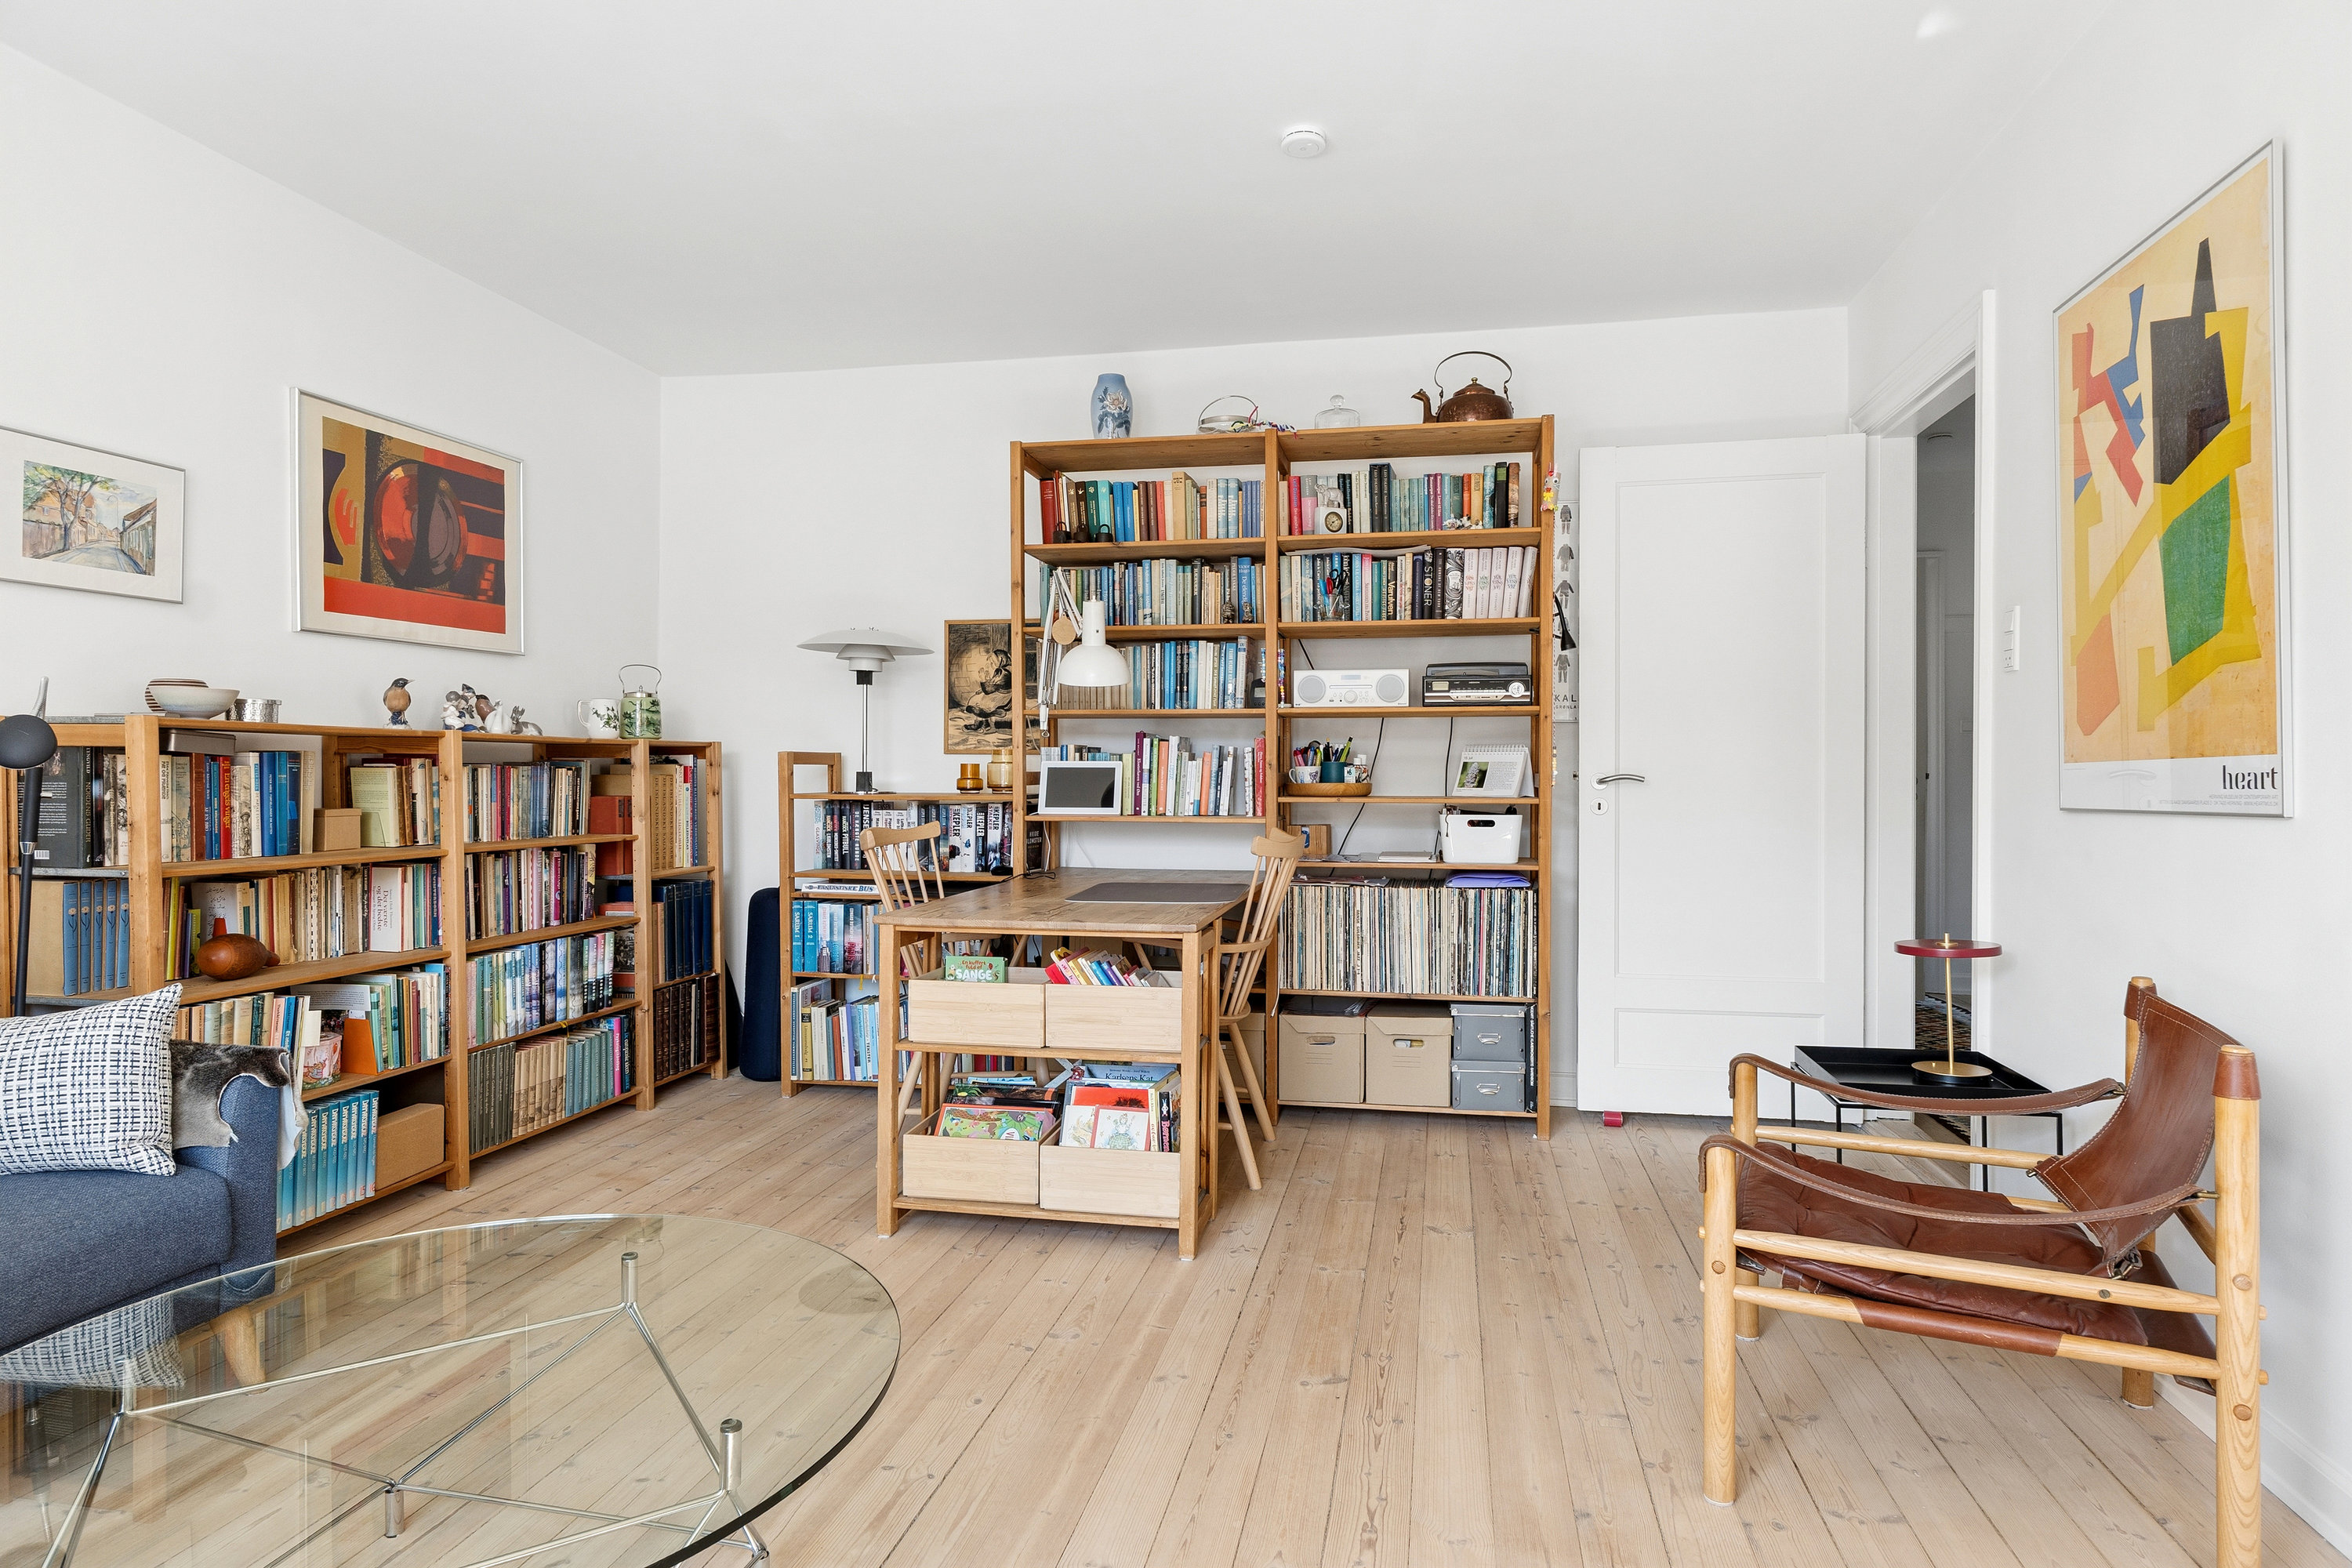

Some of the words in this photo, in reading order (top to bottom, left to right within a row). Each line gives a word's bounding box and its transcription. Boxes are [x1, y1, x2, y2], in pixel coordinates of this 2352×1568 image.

[1242, 576, 1247, 585] De
[1424, 566, 1433, 606] STONER
[1387, 580, 1396, 615] Varulven
[224, 773, 230, 782] En
[2222, 764, 2279, 790] heart
[222, 783, 230, 806] engels
[976, 815, 985, 837] KEPLER
[848, 942, 856, 961] PARIS
[955, 968, 993, 981] SANGE
[1105, 1073, 1138, 1081] Karlsens
[360, 1185, 366, 1196] 15
